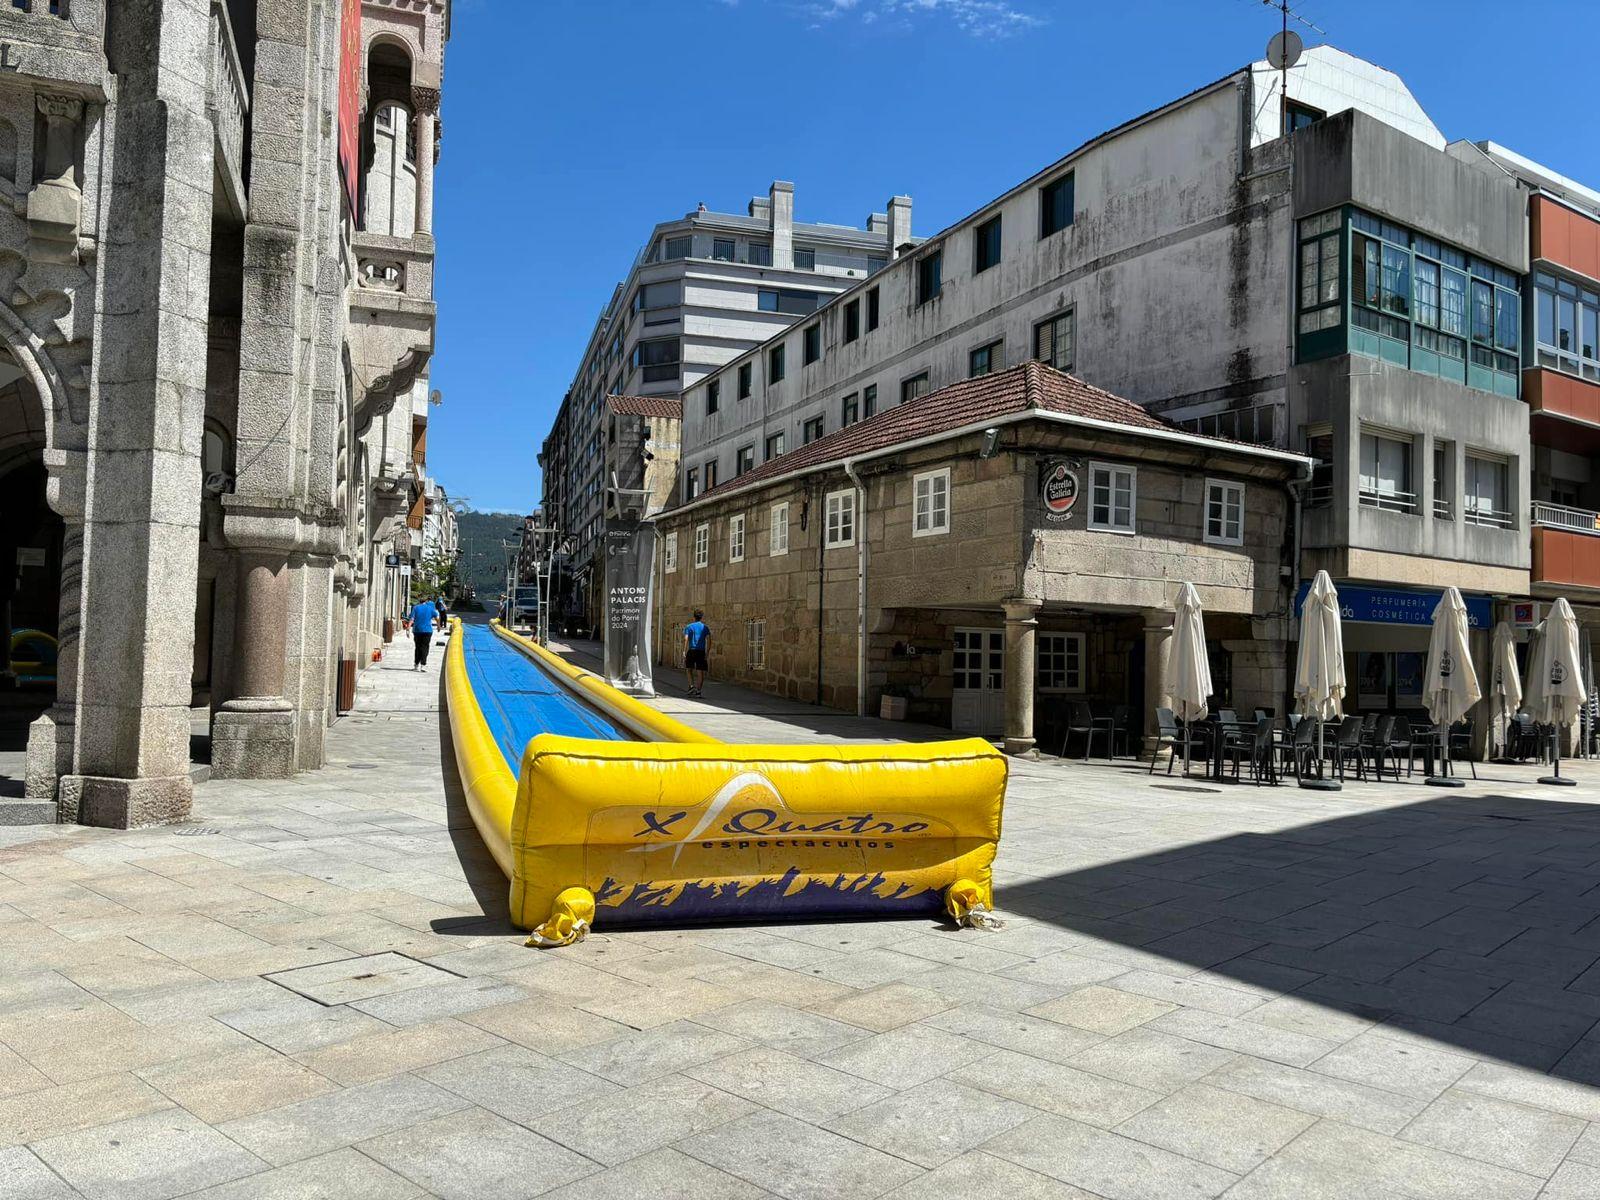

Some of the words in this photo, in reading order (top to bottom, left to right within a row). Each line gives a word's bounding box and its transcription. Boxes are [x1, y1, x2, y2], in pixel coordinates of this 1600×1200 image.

[1049, 479, 1073, 491] Estrella
[1050, 488, 1072, 500] Galicia
[1370, 596, 1427, 607] PERFUMERÍA
[1371, 609, 1427, 621] COSMÉTICA
[633, 811, 687, 837] X
[722, 808, 929, 836] Quatro
